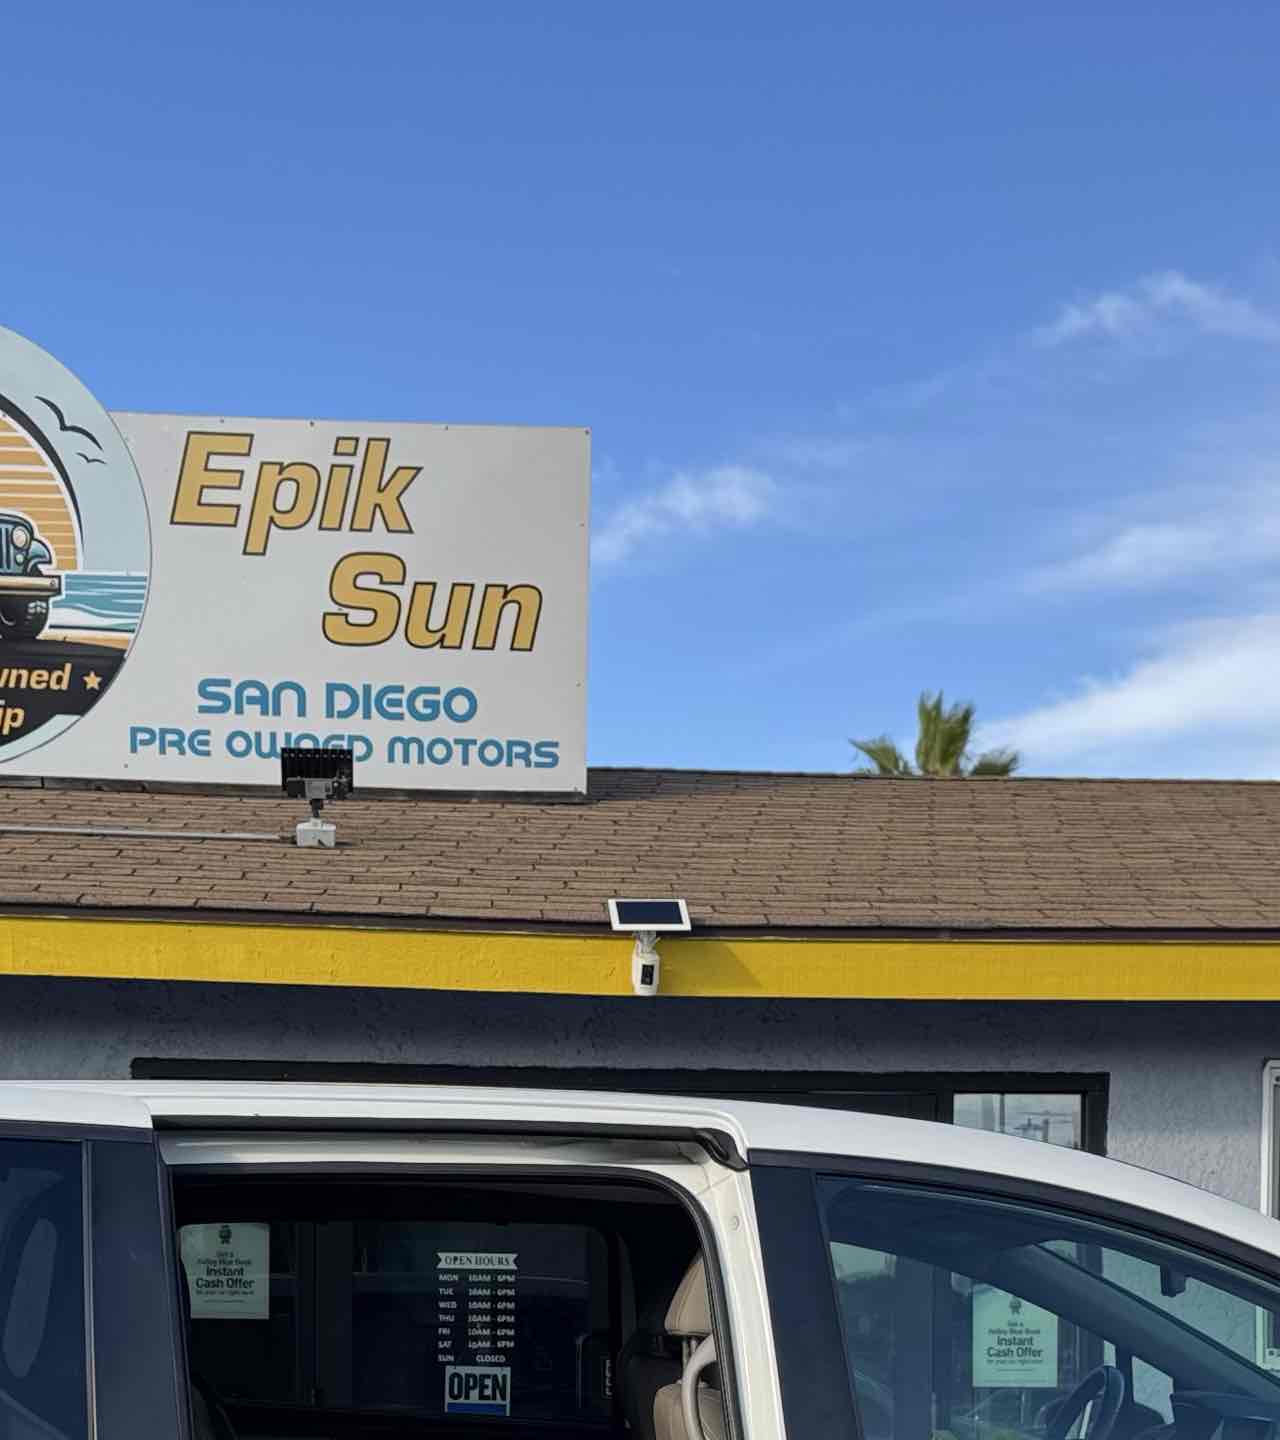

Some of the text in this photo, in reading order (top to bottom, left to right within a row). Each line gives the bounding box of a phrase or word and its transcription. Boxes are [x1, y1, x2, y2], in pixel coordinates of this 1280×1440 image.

[170, 430, 423, 555] Epik
[322, 551, 543, 652] Sun
[197, 677, 478, 723] SAN DIEGO
[129, 725, 212, 757] PRE
[387, 735, 560, 769] MOTORS
[206, 1265, 244, 1276] Instant
[444, 1254, 511, 1267] OPEN HOURS
[195, 1278, 256, 1289] Cash Offer
[987, 1346, 1043, 1357] Cash Offer
[997, 1336, 1034, 1346] Instant
[448, 1371, 508, 1401] OPEN
